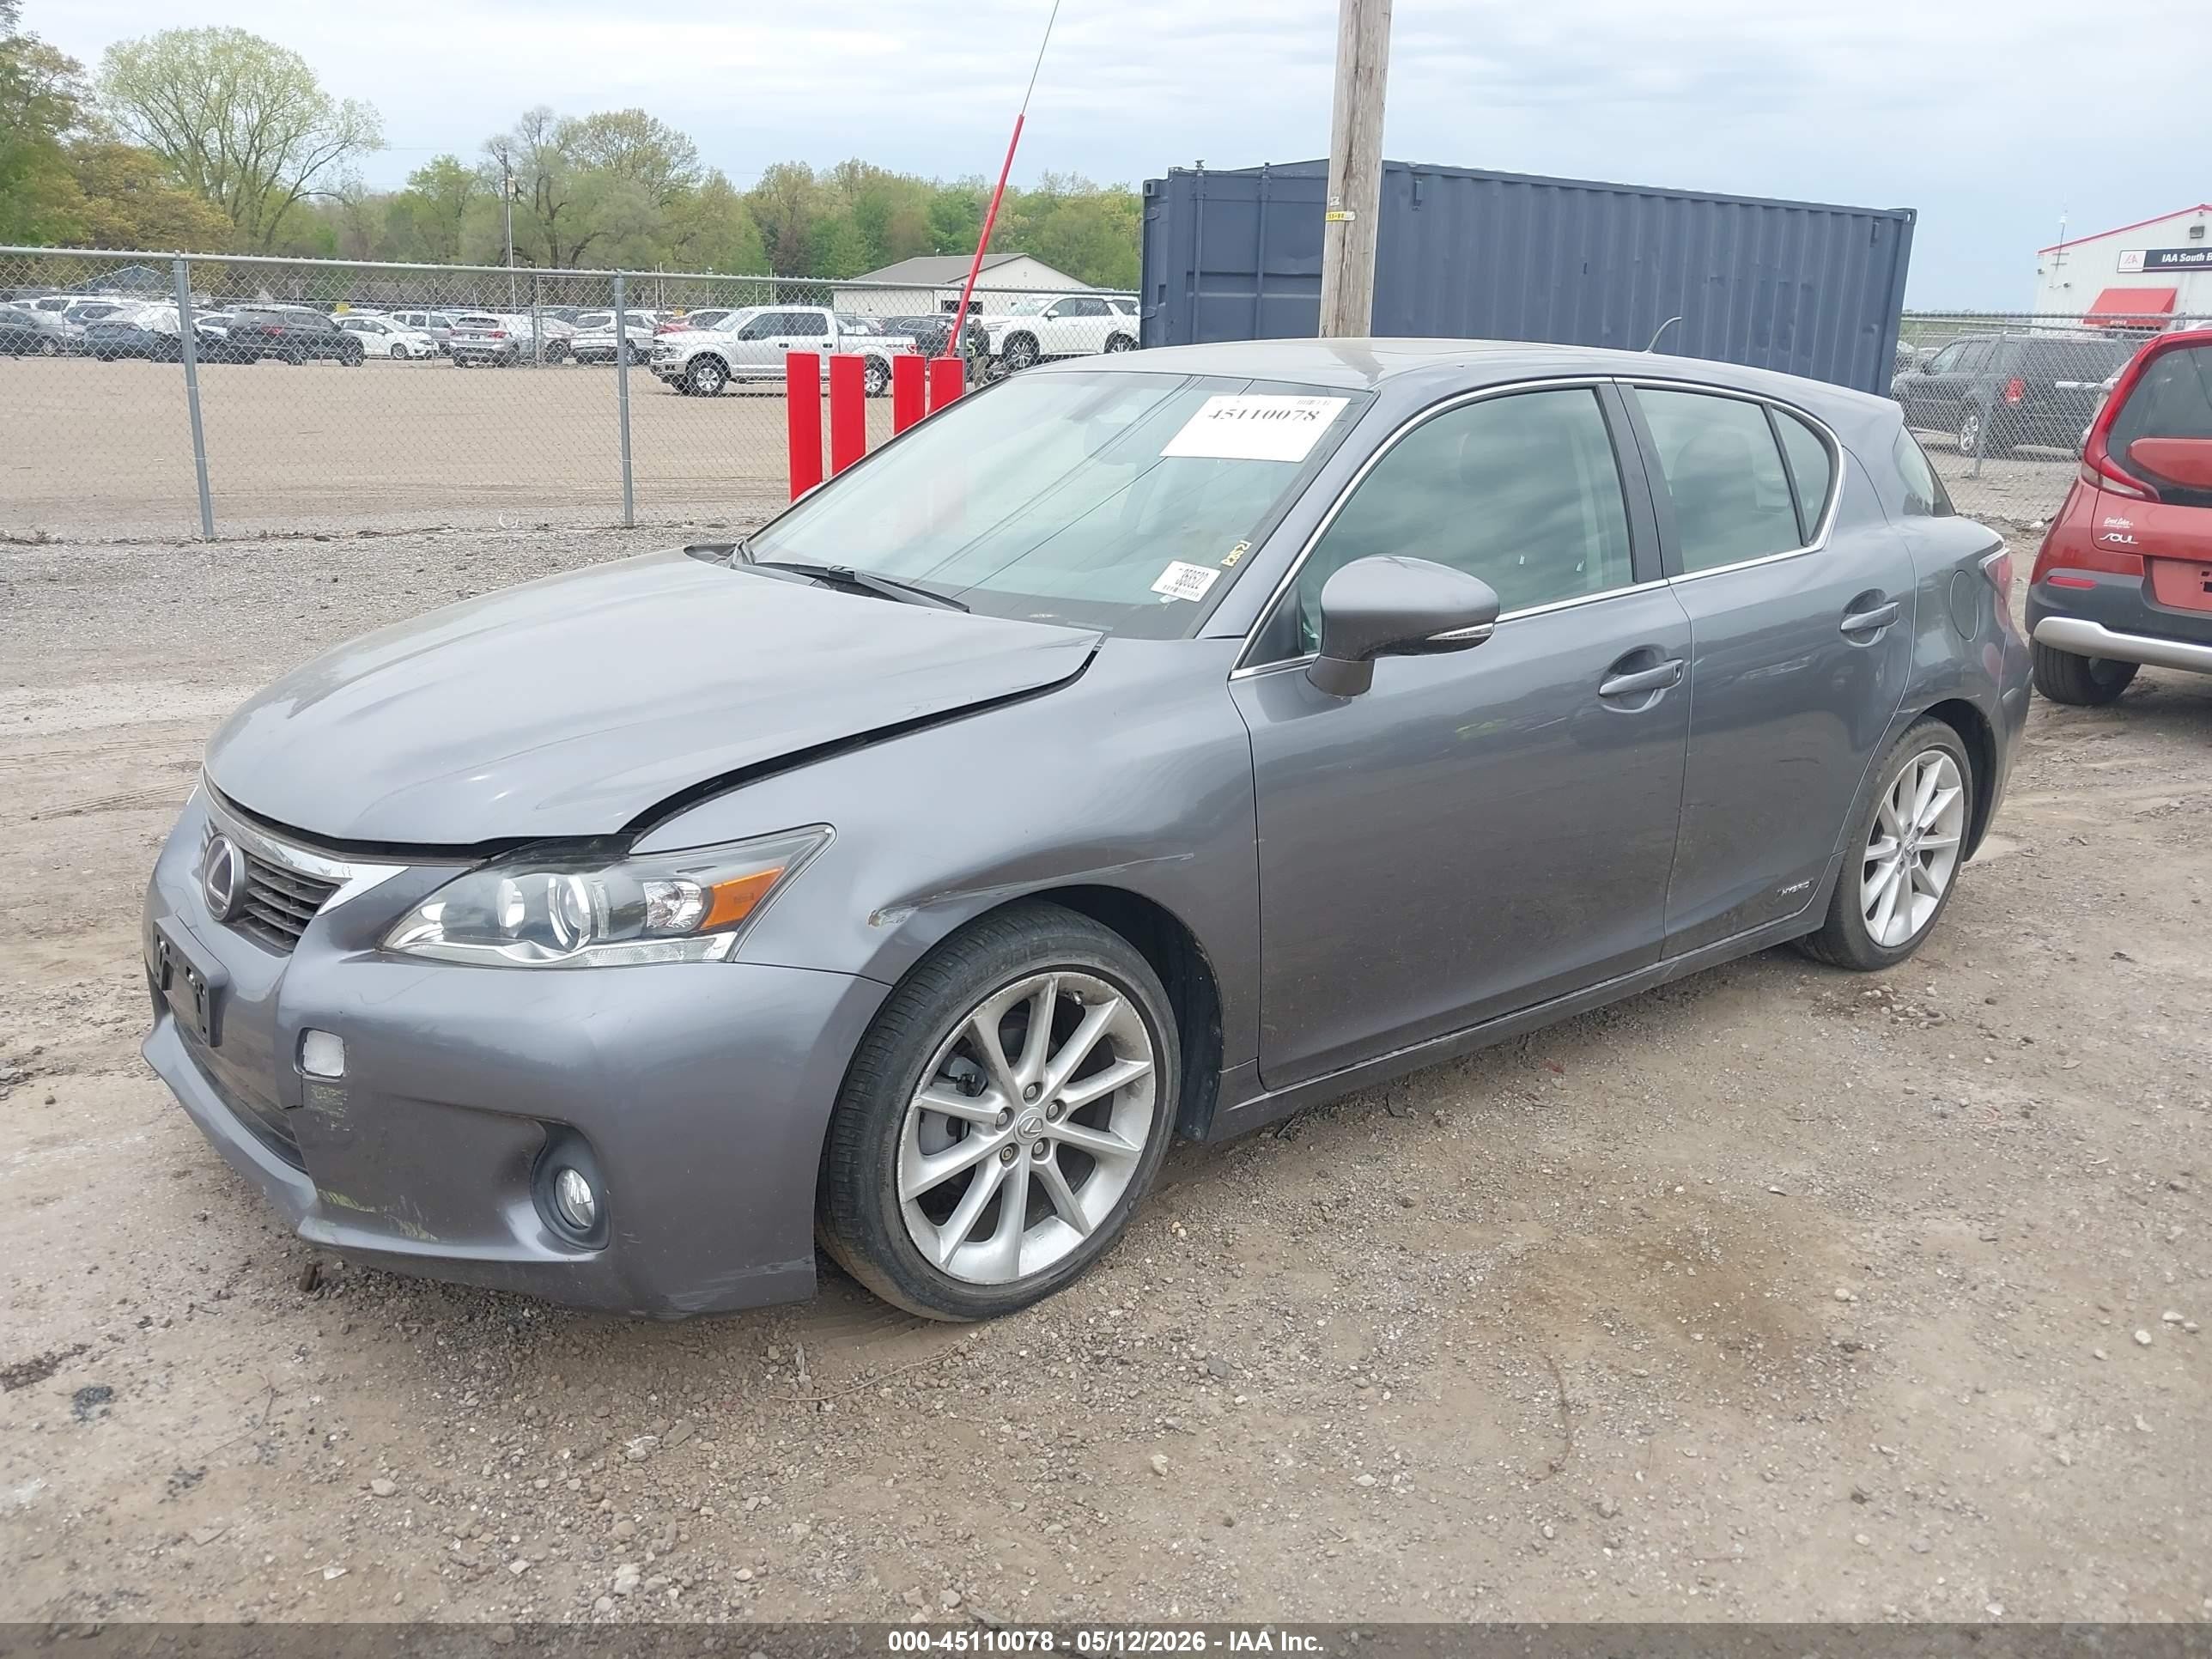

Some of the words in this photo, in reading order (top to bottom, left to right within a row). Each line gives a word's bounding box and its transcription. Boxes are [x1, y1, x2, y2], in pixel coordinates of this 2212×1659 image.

[2161, 253, 2179, 263] IAA
[2179, 252, 2205, 263] South
[1207, 408, 1321, 422] 45110078
